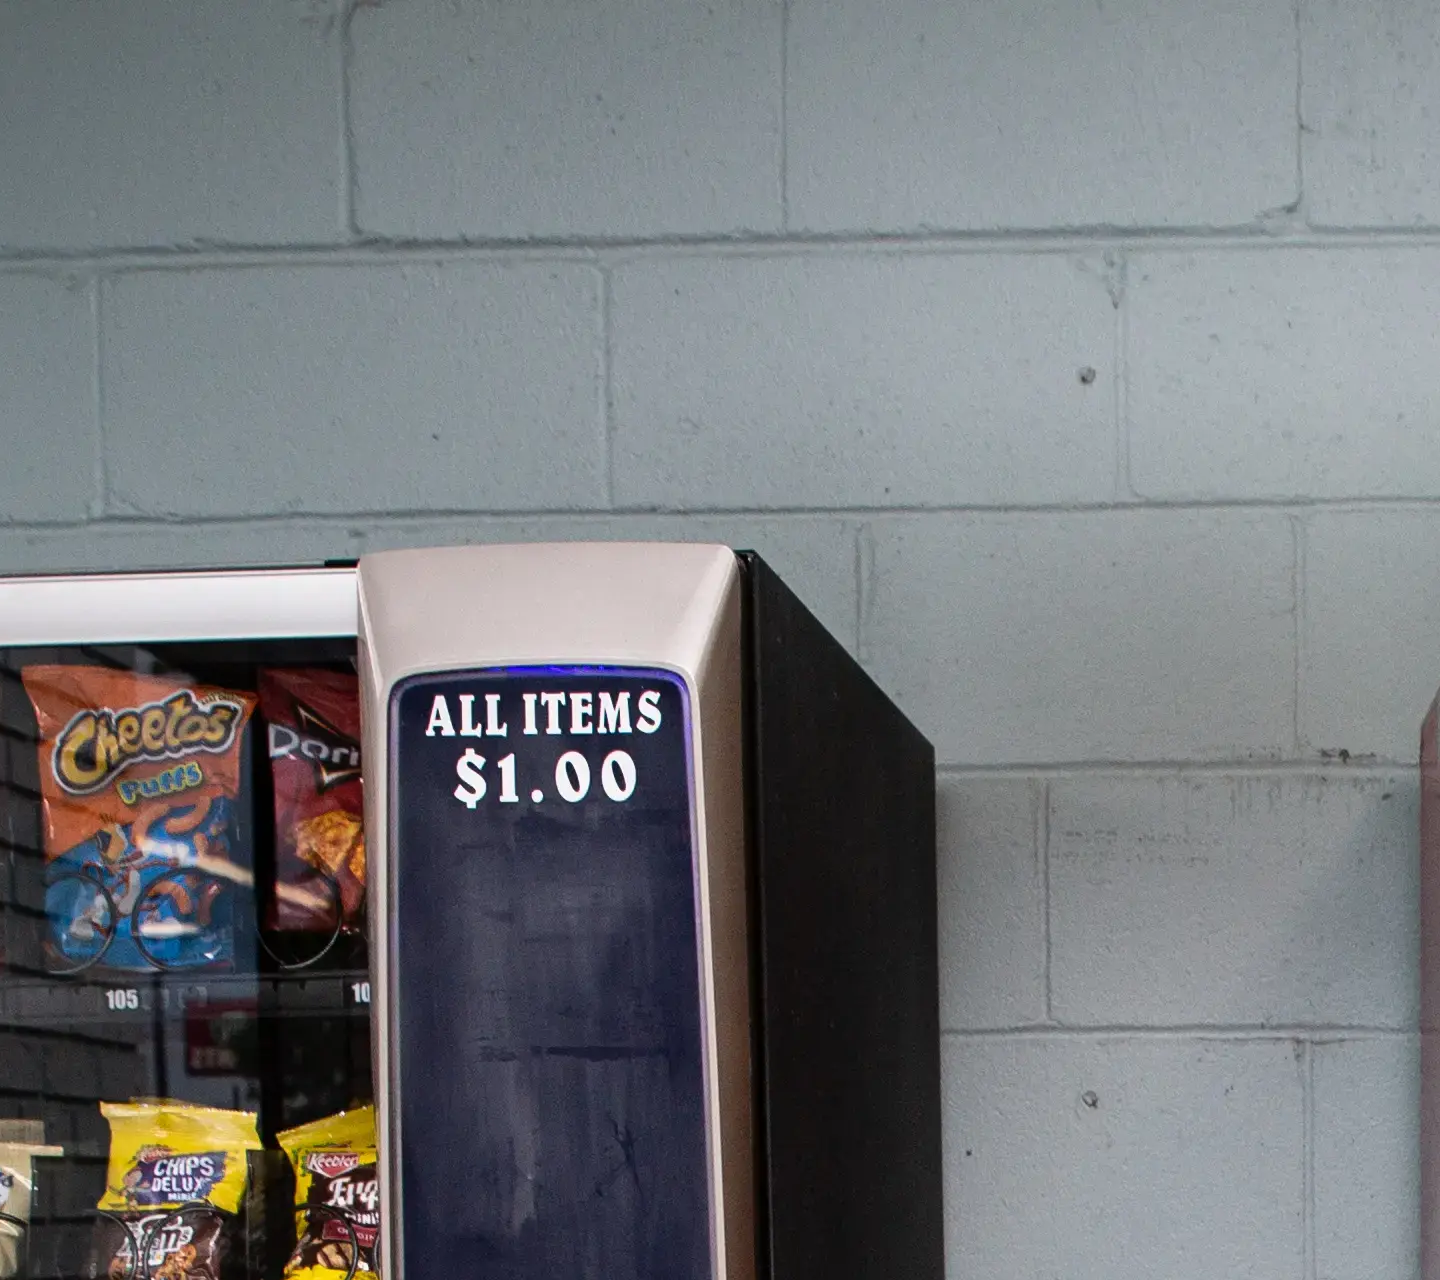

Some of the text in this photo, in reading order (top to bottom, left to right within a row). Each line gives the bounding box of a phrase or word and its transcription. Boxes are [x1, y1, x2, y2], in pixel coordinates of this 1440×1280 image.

[425, 690, 662, 737] ALL ITEMS
[56, 693, 239, 790] Cheetos
[269, 723, 359, 766] Dori
[454, 748, 637, 809] $1.00
[105, 989, 139, 1011] 105
[351, 982, 371, 1004] 10
[153, 1156, 215, 1177] CHIPS
[151, 1177, 212, 1192] DELUX
